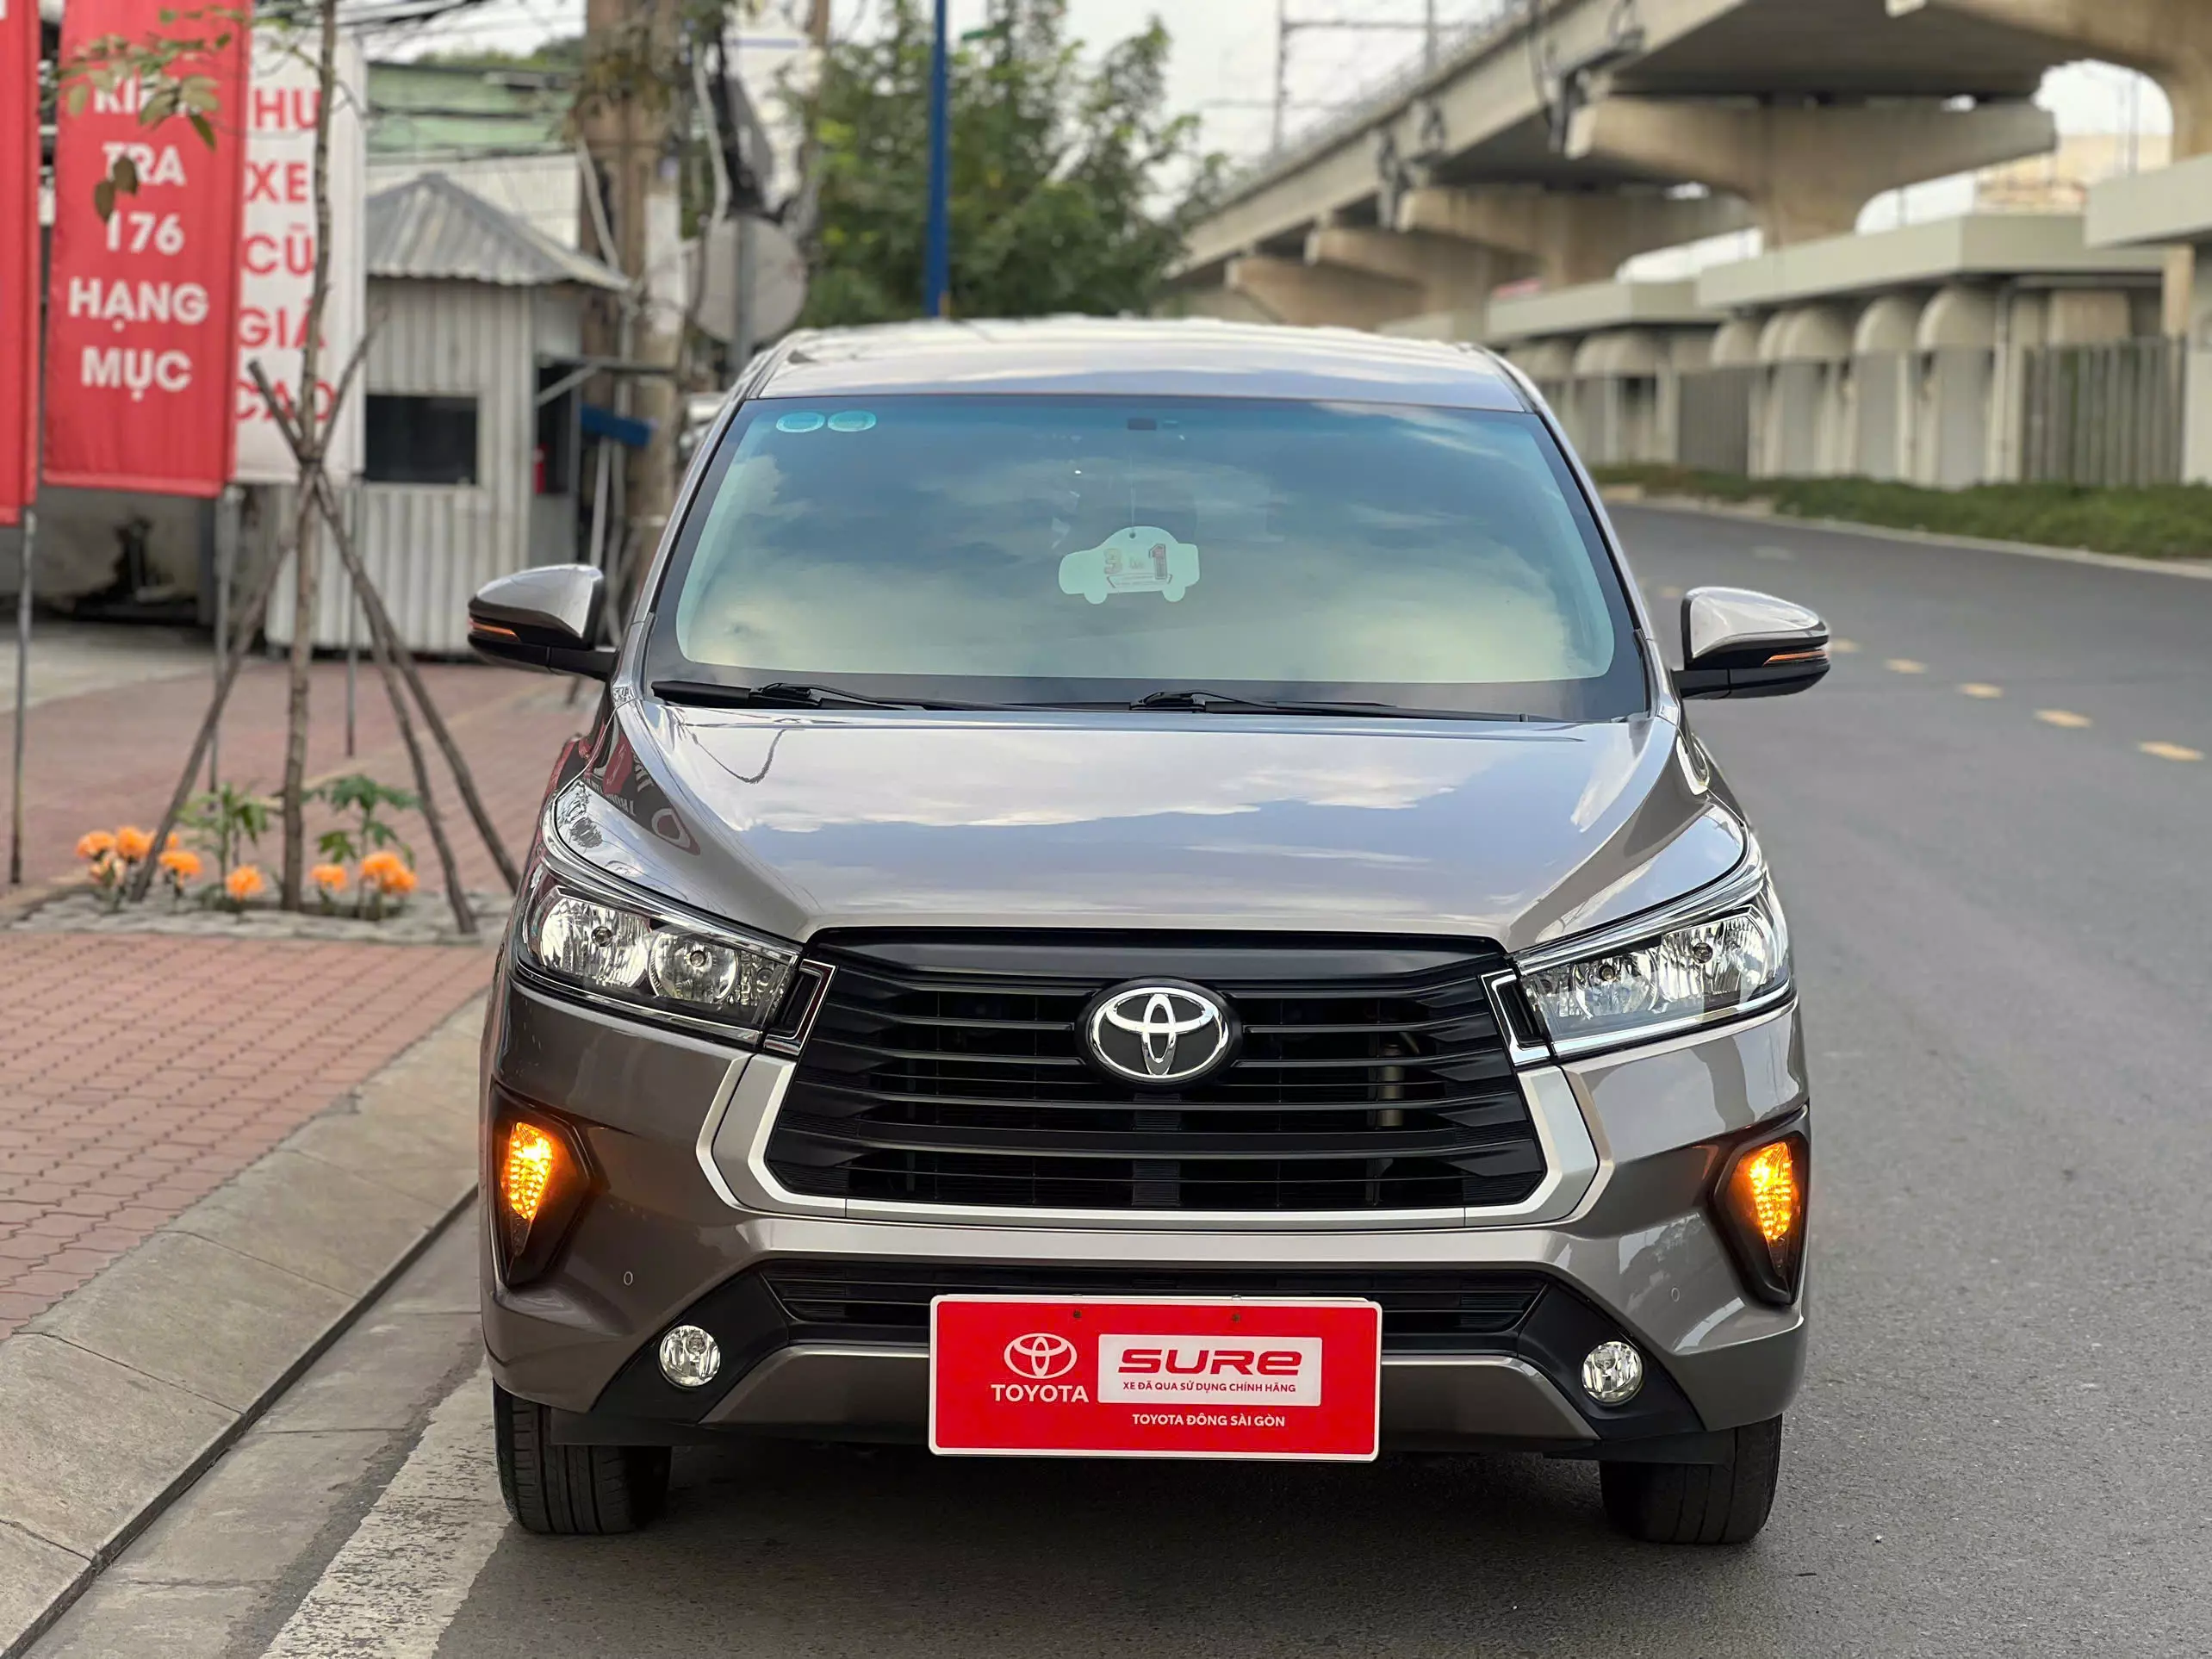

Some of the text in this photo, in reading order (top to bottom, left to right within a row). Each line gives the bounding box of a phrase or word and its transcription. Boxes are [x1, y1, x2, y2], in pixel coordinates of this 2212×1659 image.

[94, 72, 203, 114] KI
[101, 141, 187, 187] TRA
[245, 161, 308, 204] XE
[106, 209, 185, 256] 176
[242, 222, 315, 277] CŨ
[68, 275, 209, 332] HẠNG
[80, 345, 193, 402] MỤC
[991, 1383, 1090, 1403] TOYOTA
[1122, 1382, 1135, 1390] XE
[1138, 1380, 1153, 1391] ĐÃ
[1154, 1382, 1177, 1391] QUA
[1196, 1382, 1227, 1394] DỤNG
[1229, 1382, 1263, 1392] CHÍNH
[1265, 1382, 1296, 1393] HÃNG
[1132, 1413, 1286, 1427] TOYOTA ĐÔNG SÀI GÒN
